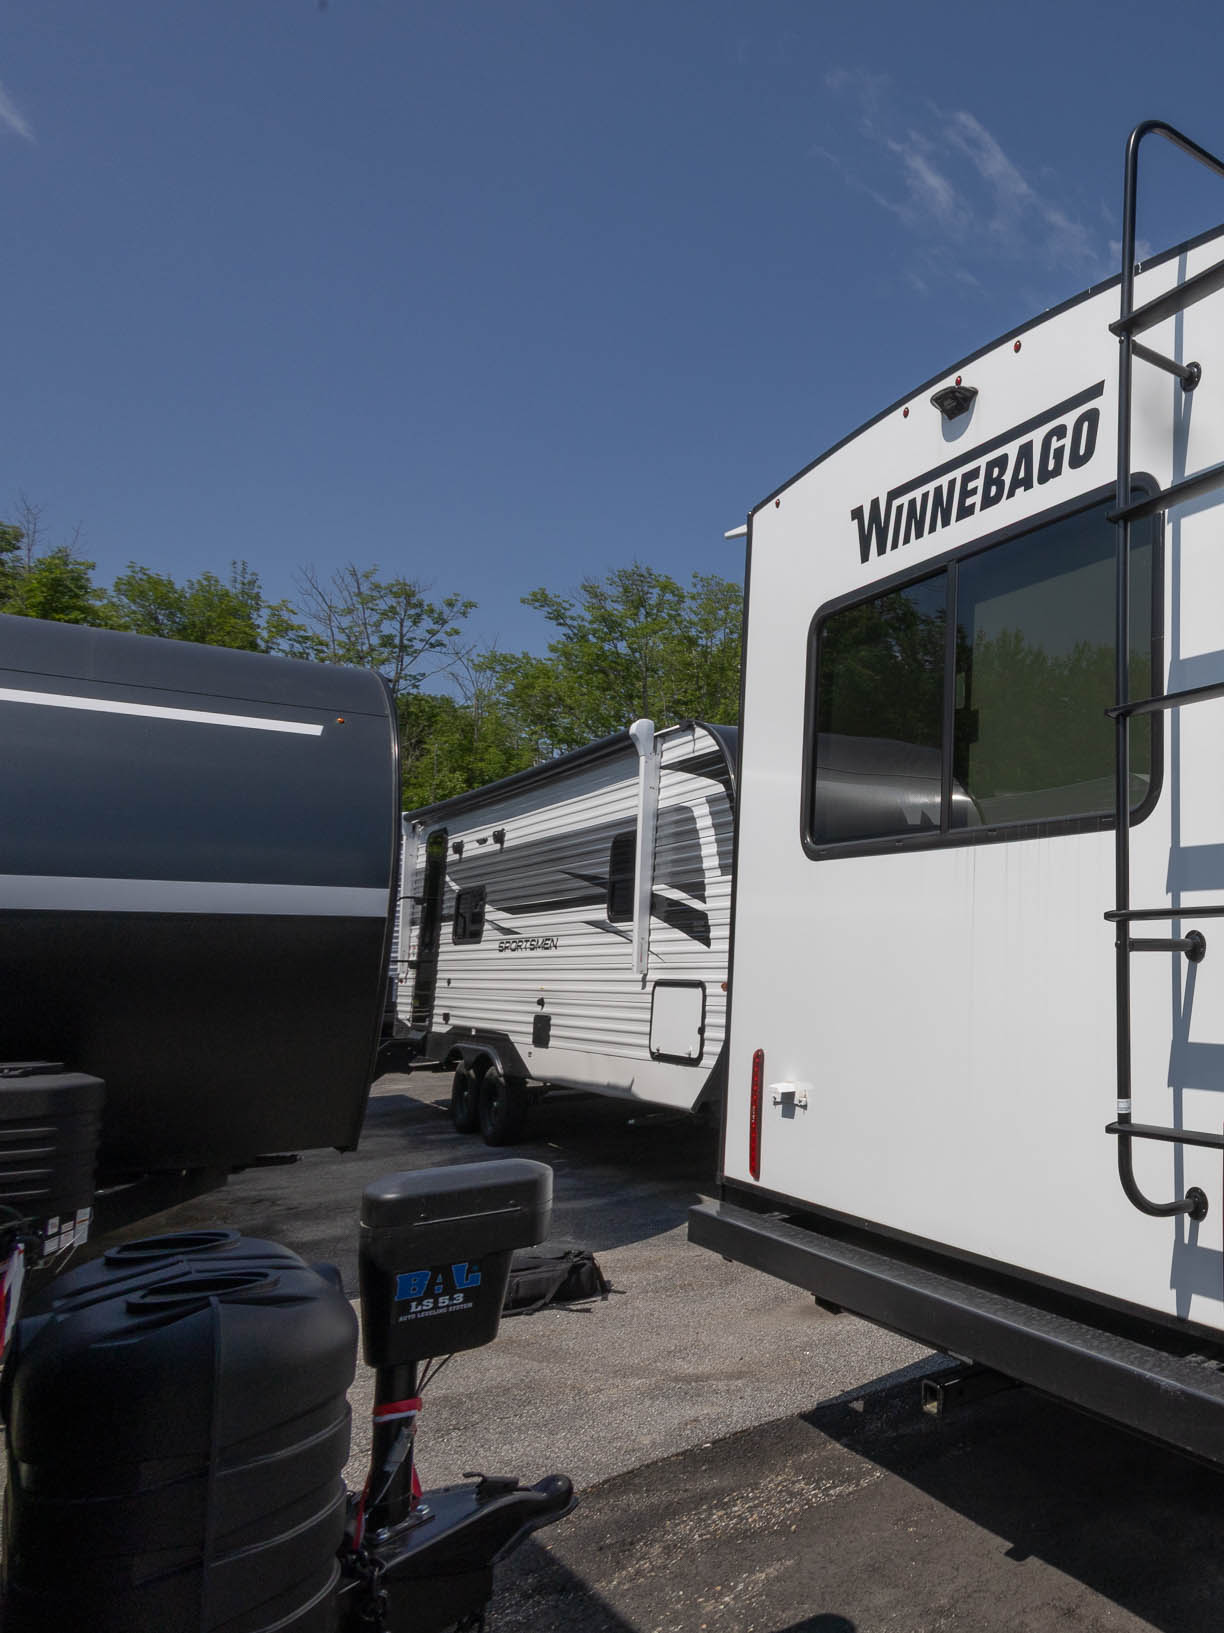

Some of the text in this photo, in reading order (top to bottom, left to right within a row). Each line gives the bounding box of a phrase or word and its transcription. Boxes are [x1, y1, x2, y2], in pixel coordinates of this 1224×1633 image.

[850, 407, 1101, 564] WINNEBAGO
[498, 937, 559, 952] SPORTSMEN
[399, 1311, 417, 1322] AUTO
[448, 1302, 473, 1312] SYSTEM
[410, 1293, 464, 1313] LS 5.3
